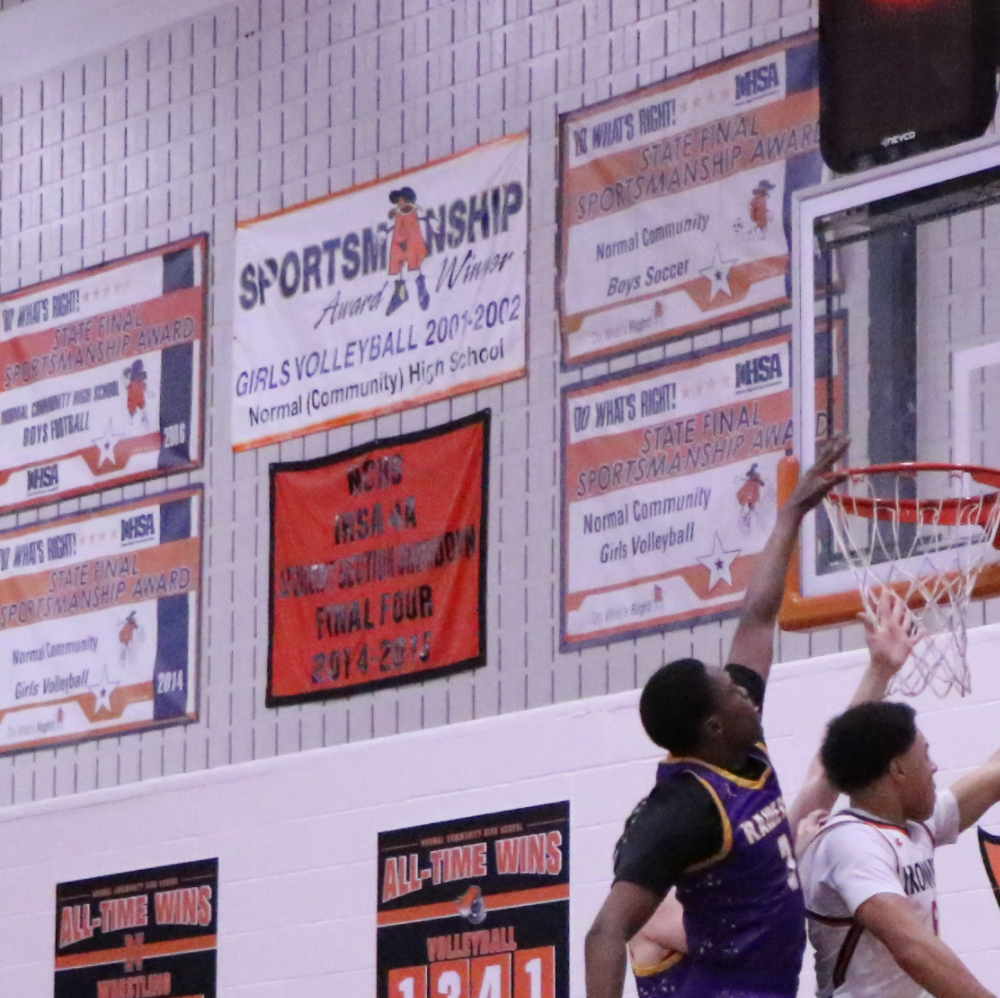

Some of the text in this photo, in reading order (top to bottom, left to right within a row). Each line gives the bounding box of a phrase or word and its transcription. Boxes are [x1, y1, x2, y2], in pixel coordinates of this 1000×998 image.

[592, 113, 634, 150] WHAT'S
[639, 99, 676, 136] RIGHT!
[640, 115, 759, 172] STATE FINAL
[577, 147, 741, 220] SPORTSMANSHIP
[596, 212, 709, 261] Normal Community
[436, 249, 513, 293] Winner
[607, 258, 690, 298] Boys Soccer
[18, 299, 49, 328] WHAT'S
[54, 307, 143, 350] STATE FINAL
[314, 281, 388, 329] Award
[5, 316, 196, 388] SPORTSMANSHIP AWARD
[236, 359, 291, 397] GIRLS
[294, 325, 418, 381] VOLLEYBALL
[249, 338, 505, 426] Normal (Community) High School
[595, 394, 636, 428] WHAT'S
[641, 383, 677, 417] RIGHT!
[23, 423, 48, 447] BOYS
[642, 401, 761, 454] STATE FINAL
[577, 433, 745, 498] SPORTSMANSHIP
[583, 487, 712, 535] Normal Community
[13, 540, 45, 568] WHAT'S
[47, 532, 77, 563] RIGHT!
[599, 522, 695, 564] Girls Volleyball
[50, 554, 138, 590] STATE FINAL
[0, 567, 190, 628] SPORTSMANSHIP AWARD
[316, 585, 433, 639] FINAL FOUR
[12, 636, 99, 666] Normal Community
[15, 668, 89, 699] Girls Volleyball
[157, 669, 184, 694] 2014
[382, 830, 562, 903] ALL-TIME WINS
[59, 894, 148, 949] ALL-TIME
[154, 884, 212, 927] WINS
[427, 926, 517, 962] VOLLEYBALL
